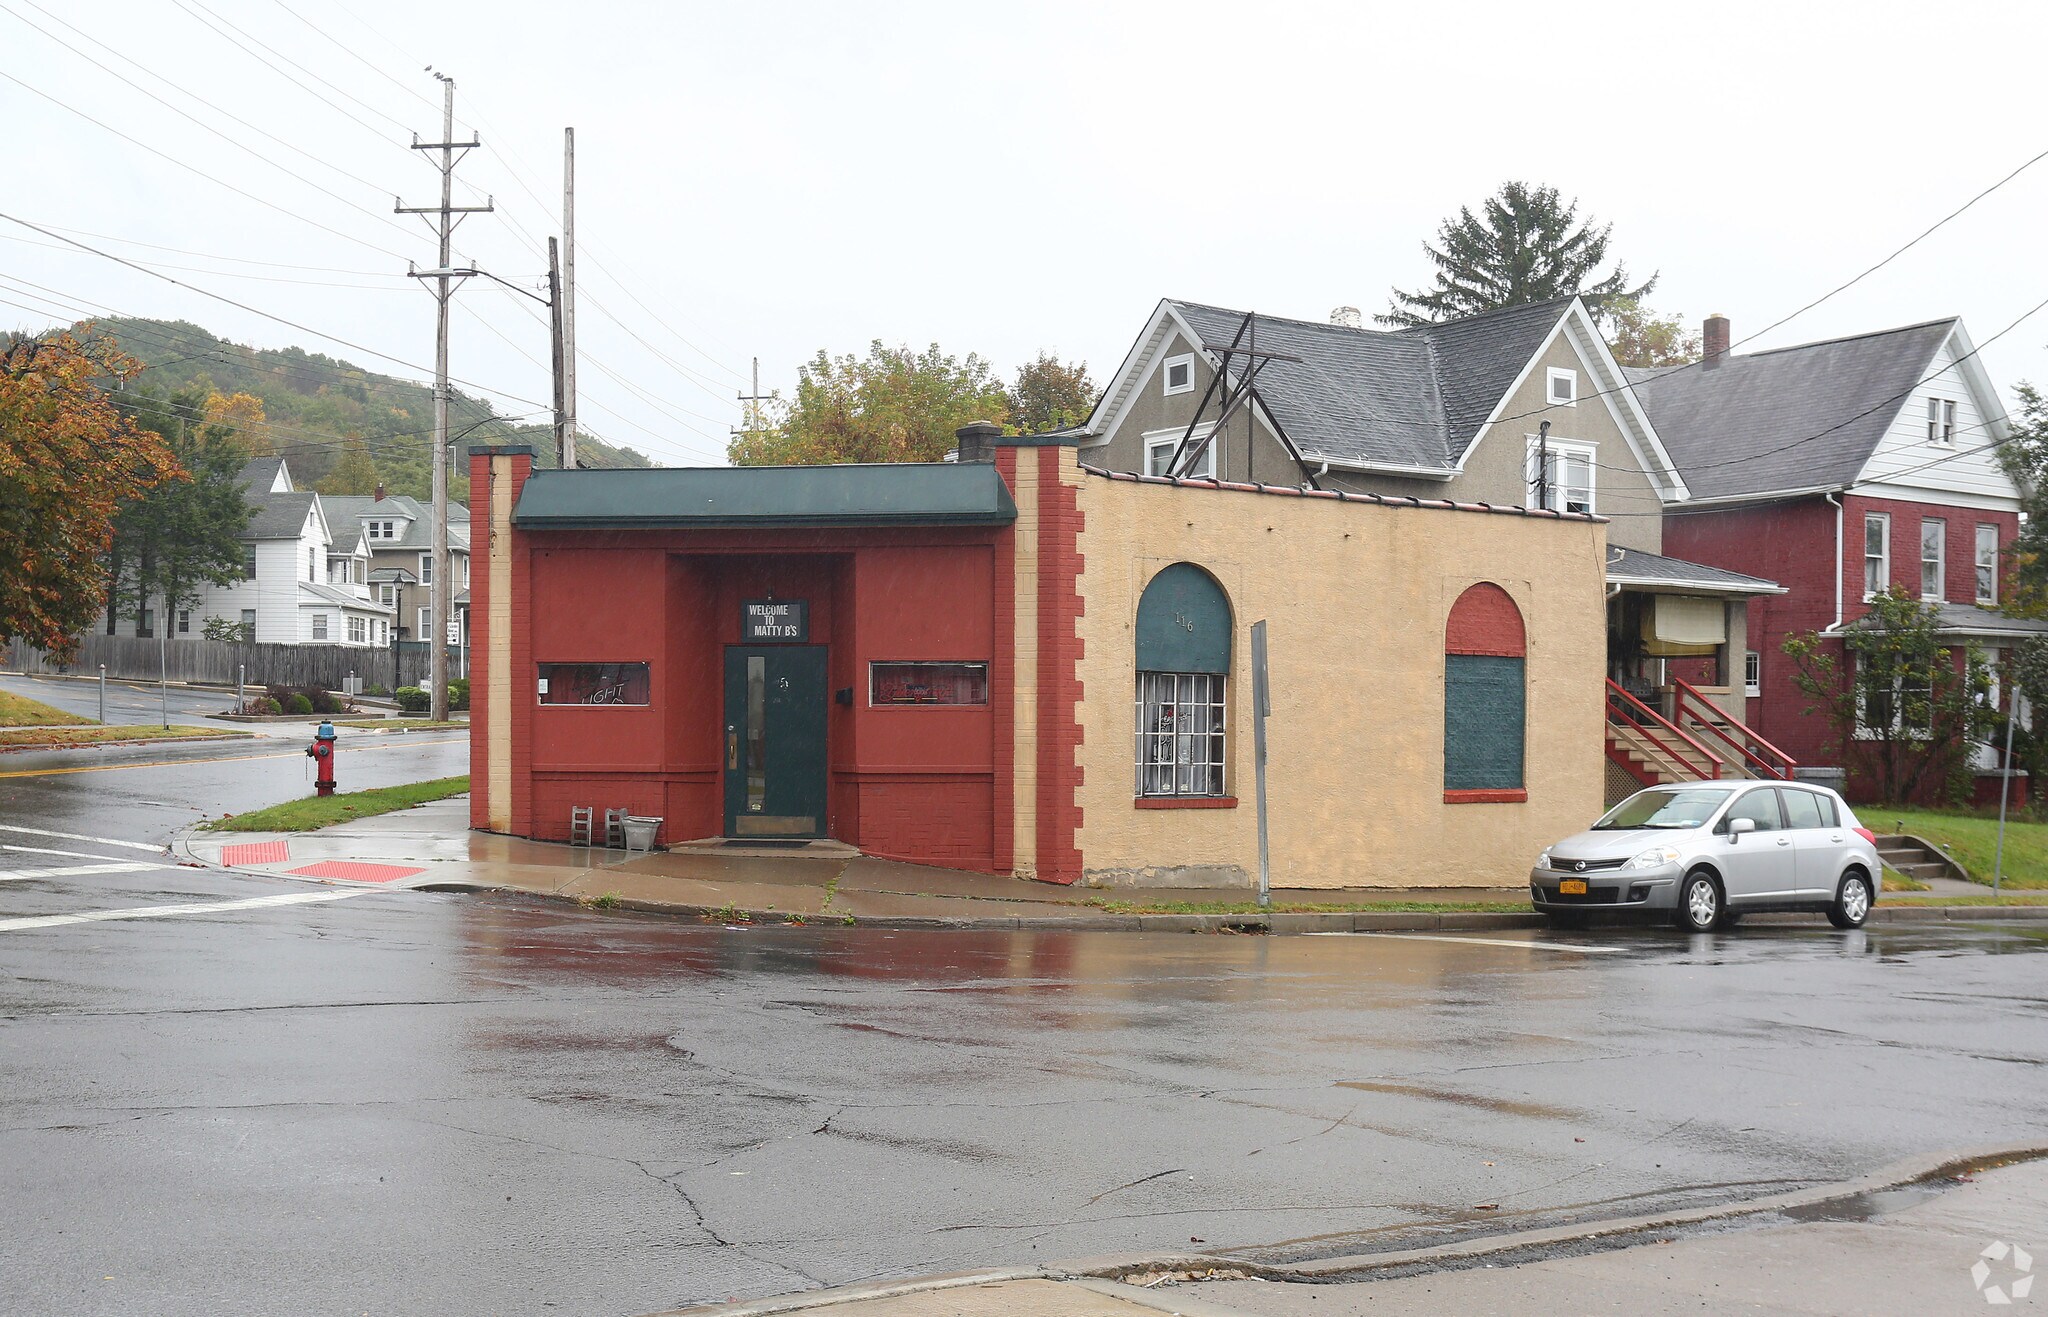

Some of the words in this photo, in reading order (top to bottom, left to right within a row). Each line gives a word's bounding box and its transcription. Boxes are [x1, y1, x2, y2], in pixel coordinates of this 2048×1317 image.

[749, 604, 788, 615] WELCOME
[764, 615, 774, 625] TO
[1175, 611, 1193, 632] 116
[754, 625, 782, 636] MATTY
[784, 625, 797, 636] B'S
